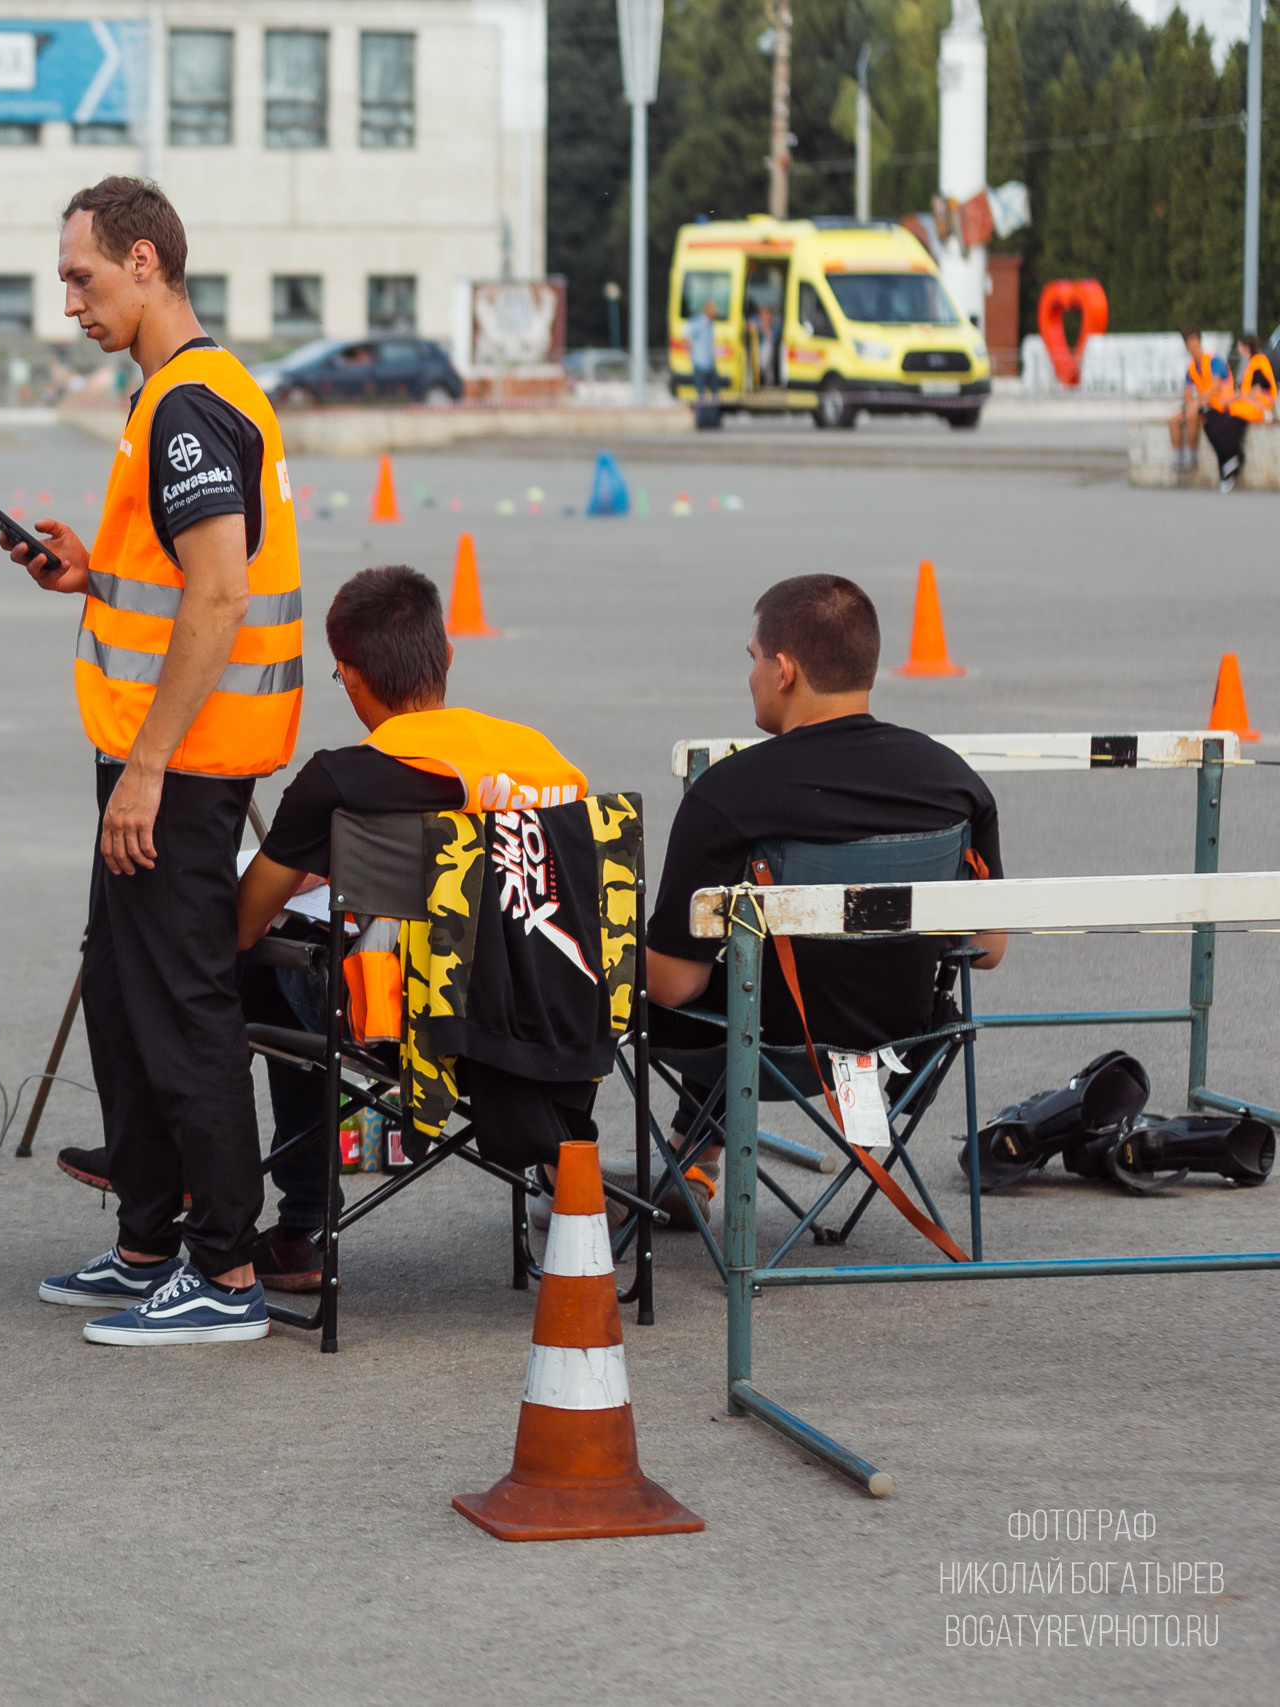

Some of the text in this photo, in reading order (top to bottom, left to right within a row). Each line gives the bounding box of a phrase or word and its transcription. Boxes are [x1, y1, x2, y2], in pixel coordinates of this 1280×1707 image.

[162, 466, 232, 503] Kawasaki
[166, 504, 174, 514] Let
[174, 499, 185, 508] the
[185, 489, 200, 505] good
[201, 486, 223, 496] times
